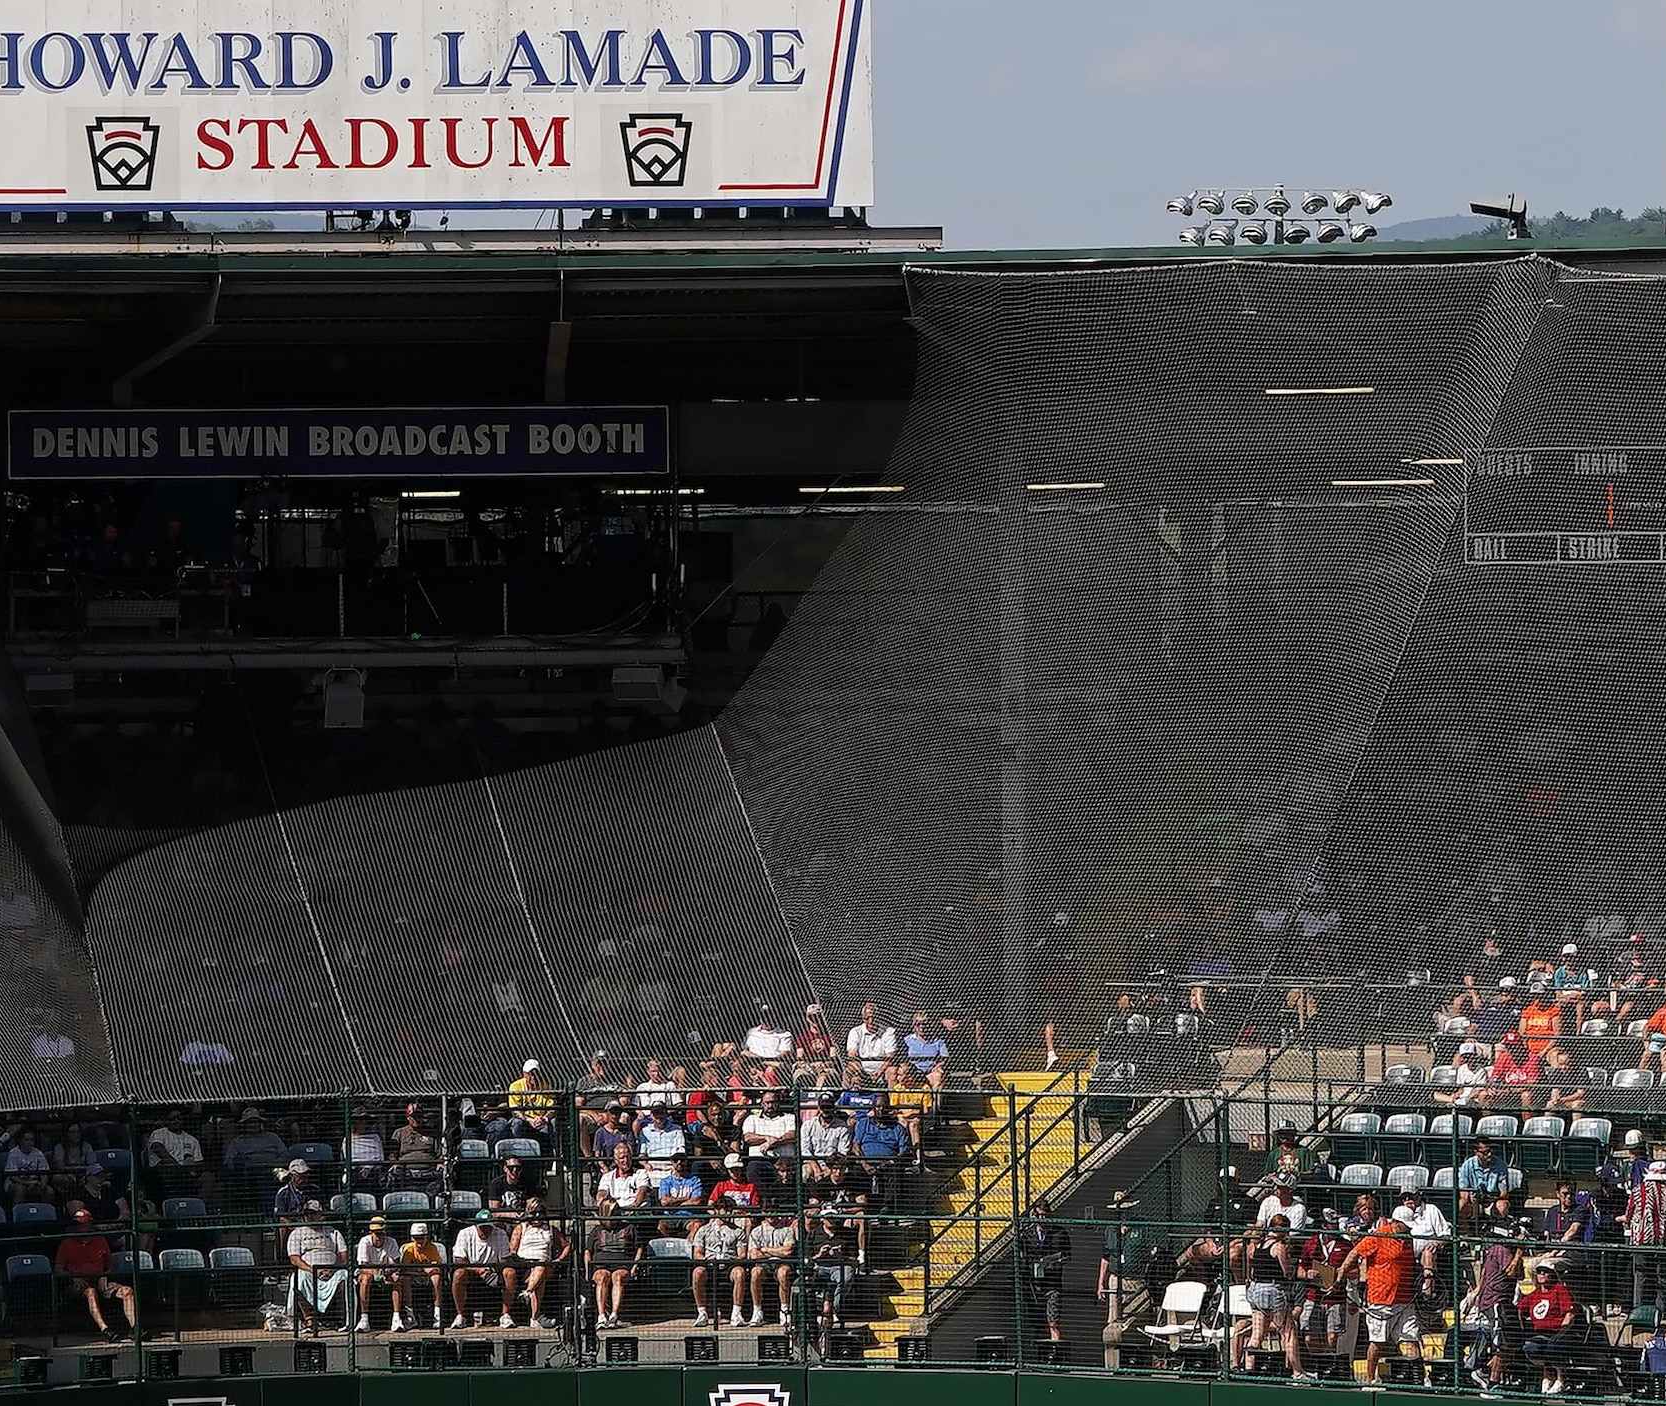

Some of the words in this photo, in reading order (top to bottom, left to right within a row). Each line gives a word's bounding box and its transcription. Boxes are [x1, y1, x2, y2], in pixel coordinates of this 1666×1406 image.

[361, 31, 412, 94] J.
[434, 28, 807, 94] LAMADE
[197, 117, 571, 170] STADIUM
[34, 427, 158, 458] DENNIS
[180, 425, 289, 457] LEWIN
[309, 423, 510, 457] BROADCAST
[529, 422, 645, 454] BOOTH
[1574, 453, 1628, 474] INNING
[1473, 538, 1507, 559] BALL
[1568, 537, 1620, 559] STRIKE
